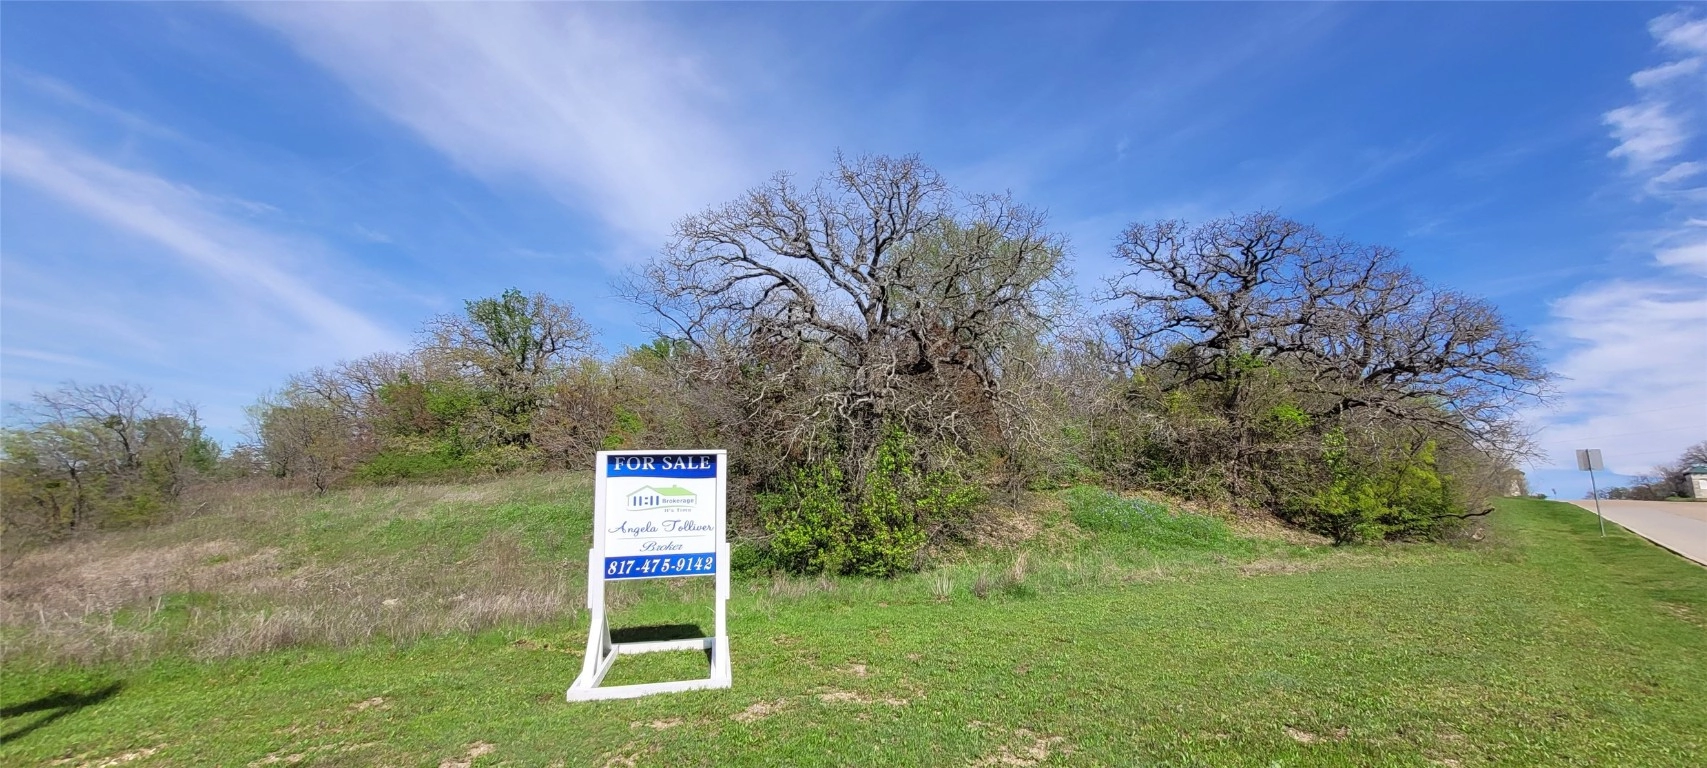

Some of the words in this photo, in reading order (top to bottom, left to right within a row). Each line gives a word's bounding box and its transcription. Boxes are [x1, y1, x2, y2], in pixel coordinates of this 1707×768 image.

[614, 456, 655, 470] FOR
[662, 456, 711, 470] SALE
[608, 521, 658, 536] Angela
[662, 520, 714, 532] Tolliver
[640, 541, 683, 552] Broker
[608, 557, 713, 575] 817-475-9142
